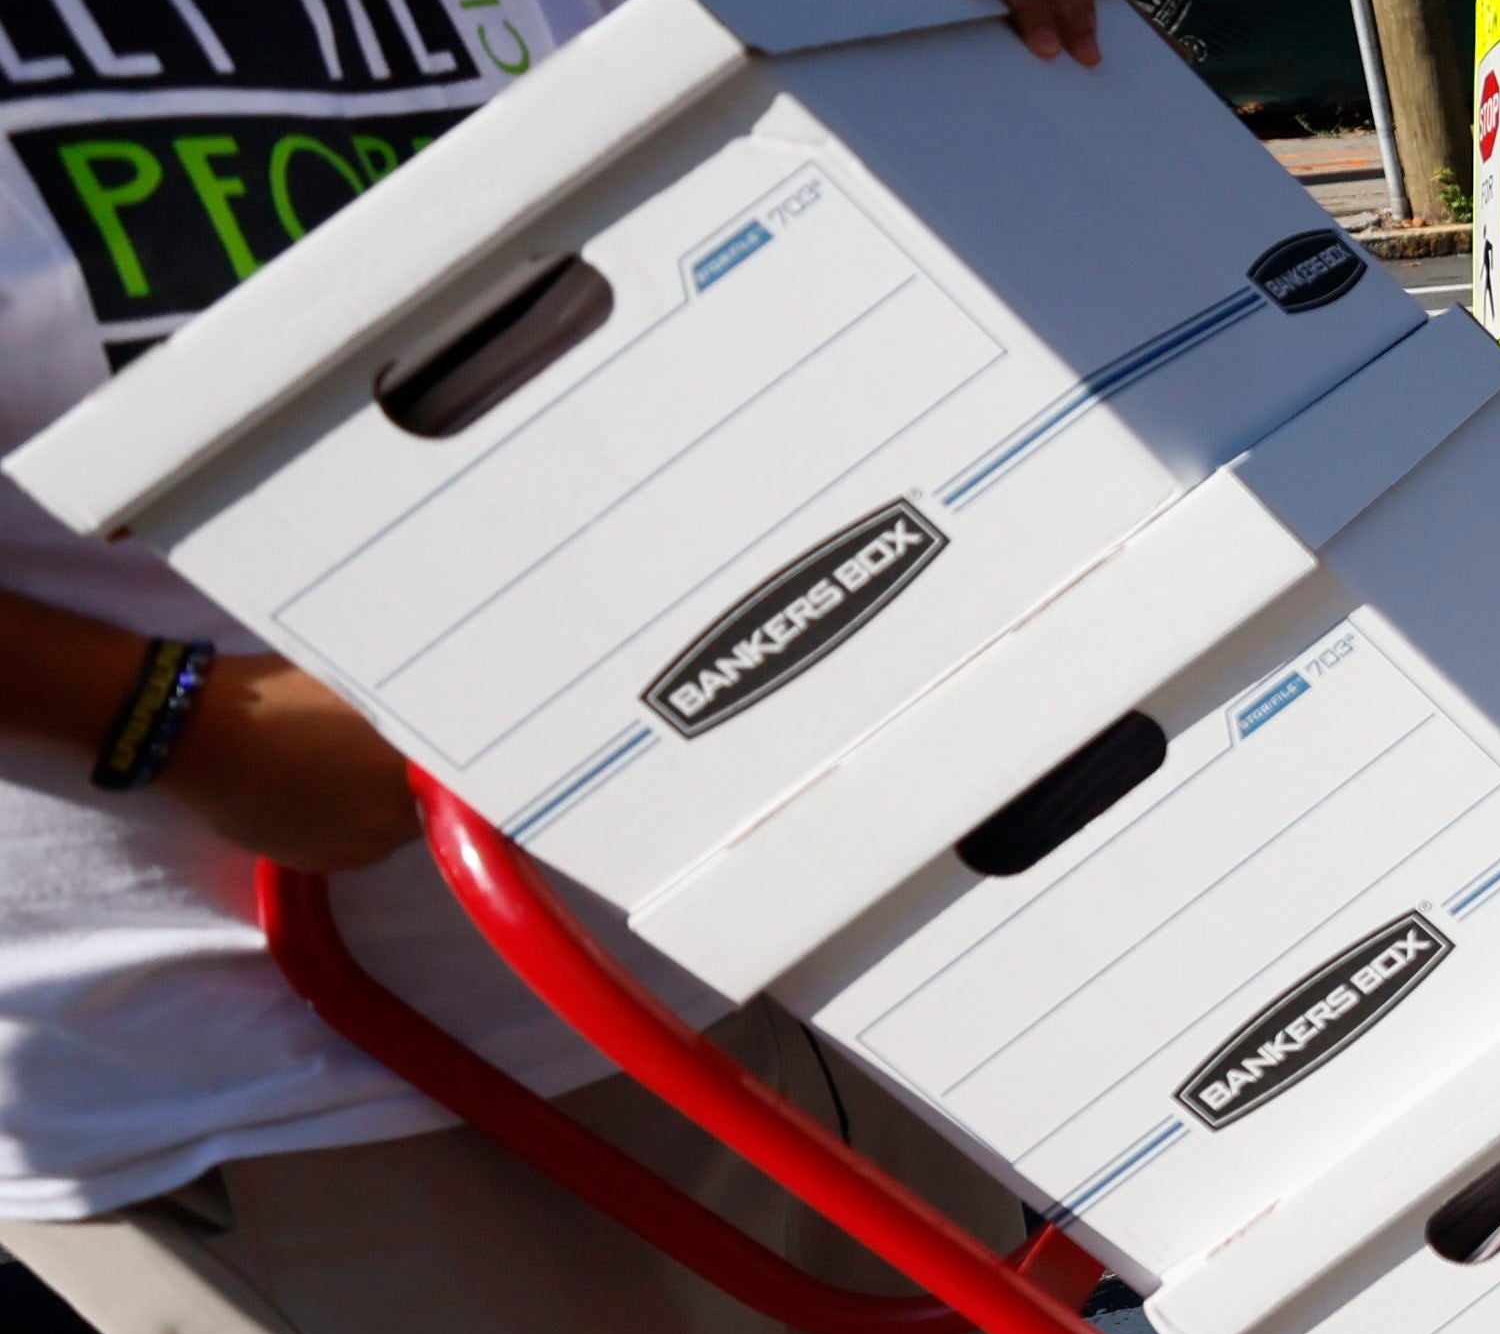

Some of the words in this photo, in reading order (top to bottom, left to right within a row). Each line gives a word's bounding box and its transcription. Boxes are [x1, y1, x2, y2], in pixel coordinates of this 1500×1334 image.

[1478, 93, 1499, 141] STOP
[1481, 175, 1494, 206] FOR
[1265, 255, 1328, 298] BANKERS
[1318, 242, 1352, 269] BOX
[668, 572, 844, 720] BANKERS
[831, 518, 925, 597] BOX
[1199, 983, 1360, 1111] BANKERS
[1351, 928, 1432, 997] BOX
